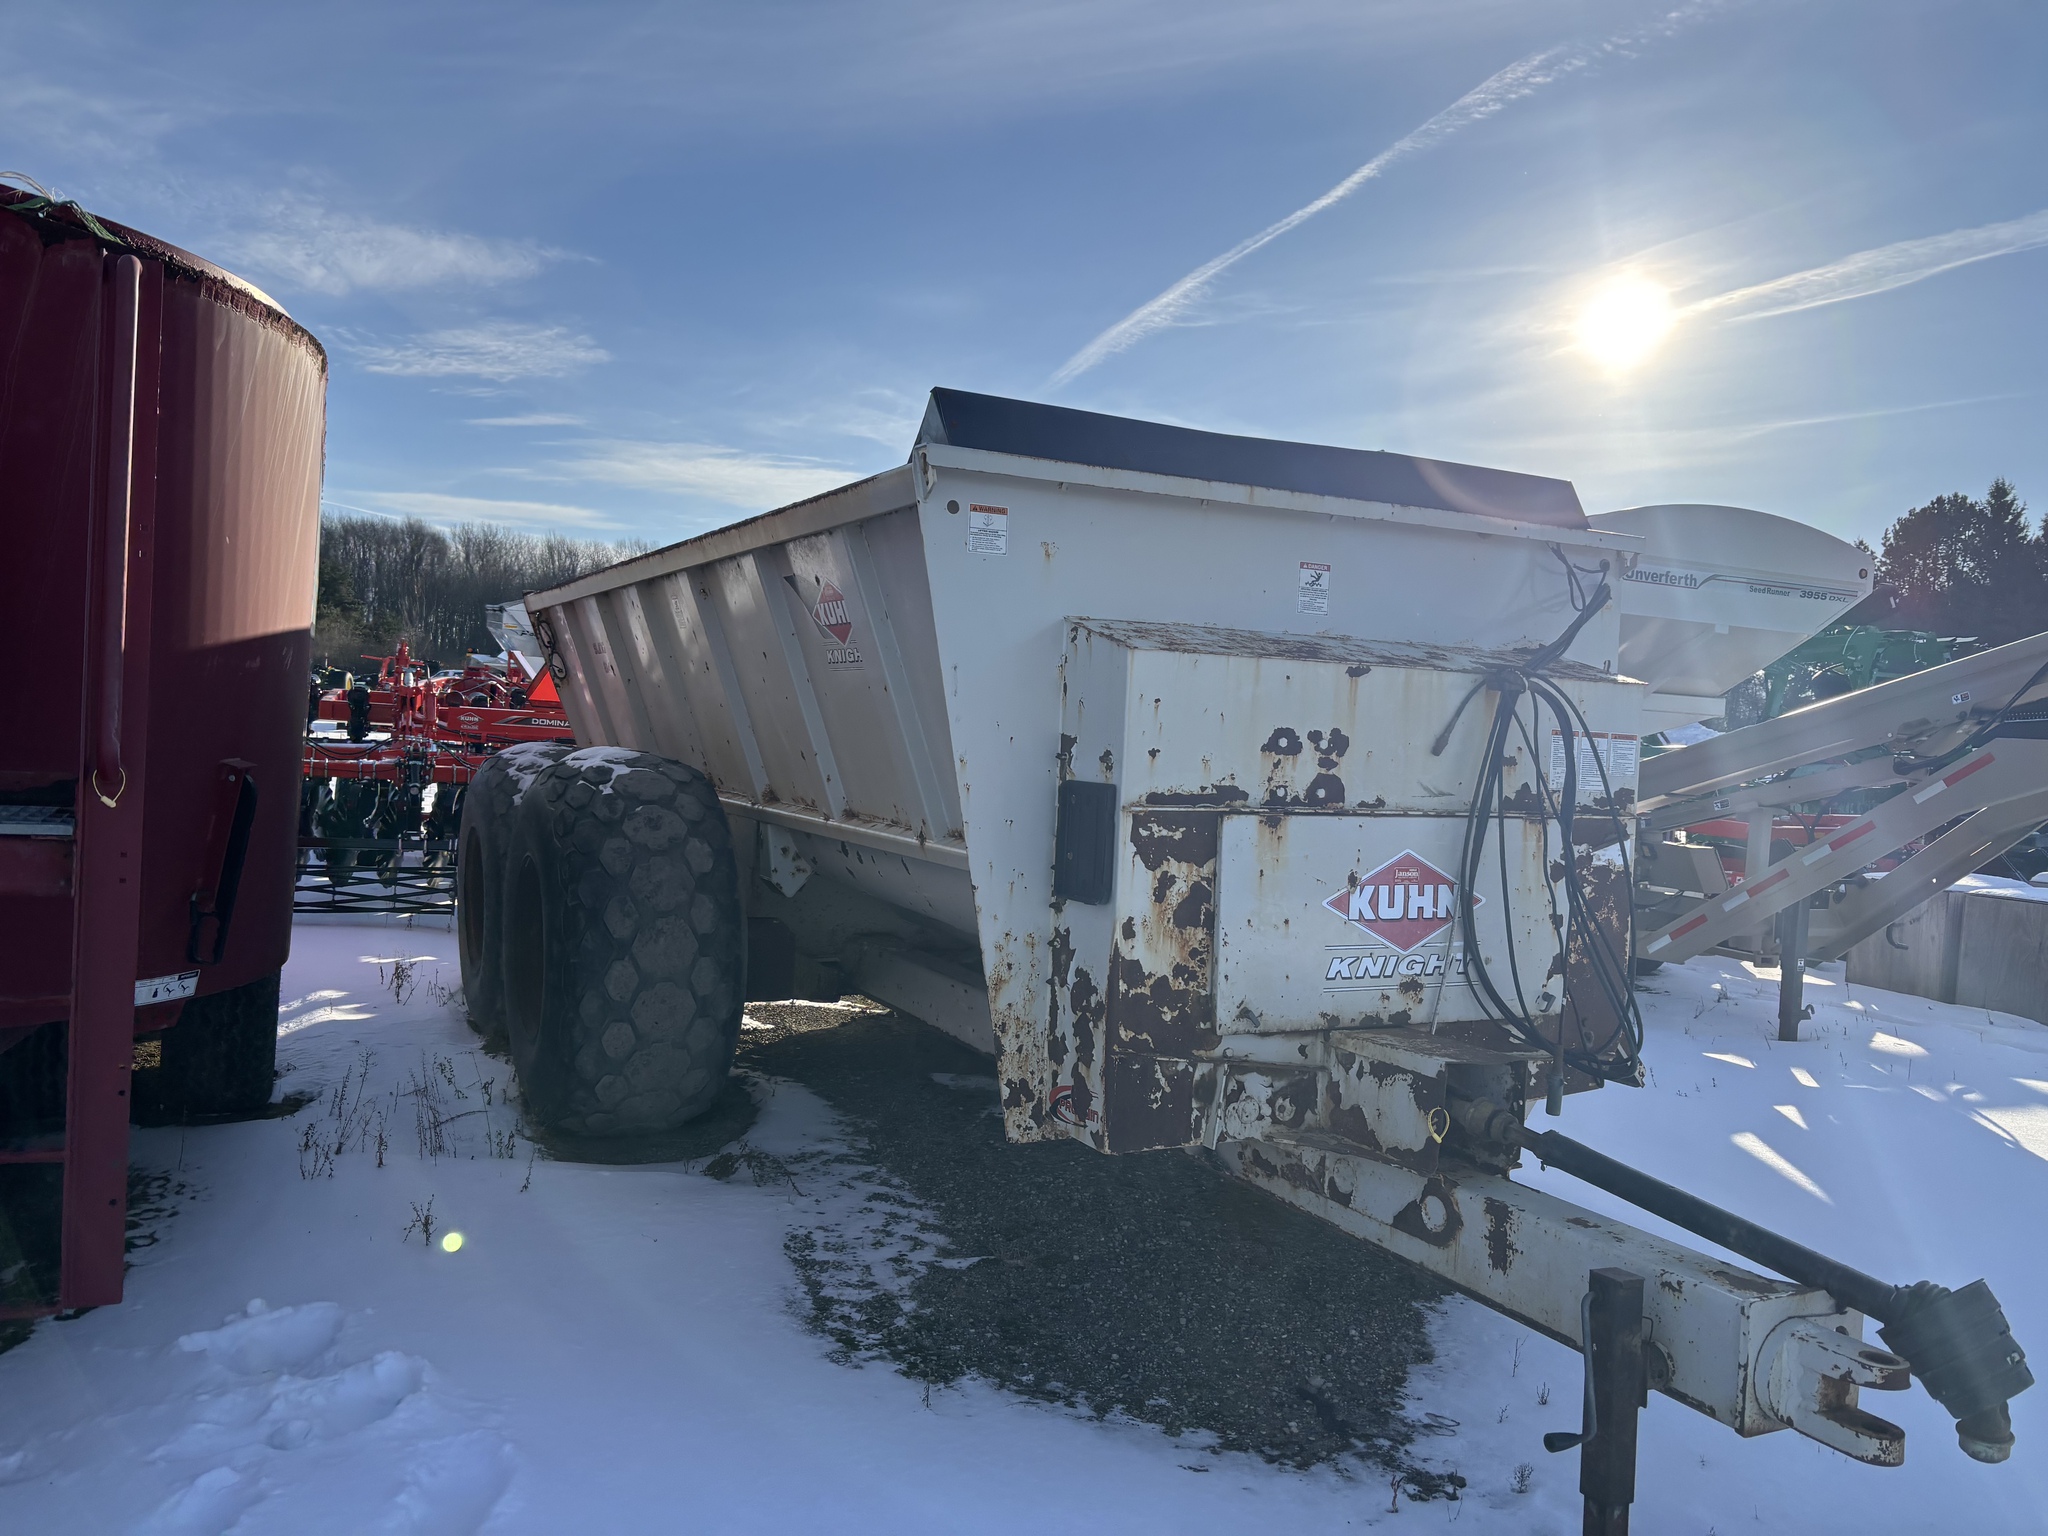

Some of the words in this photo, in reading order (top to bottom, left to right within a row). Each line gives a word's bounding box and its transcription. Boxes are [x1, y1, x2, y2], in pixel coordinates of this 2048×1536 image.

[979, 505, 1006, 515] WARNING
[1307, 563, 1328, 571] DANGER
[1799, 590, 1827, 601] 3955
[1828, 595, 1849, 603] DXL
[1394, 869, 1419, 879] Janson
[1348, 884, 1460, 922] KUHN
